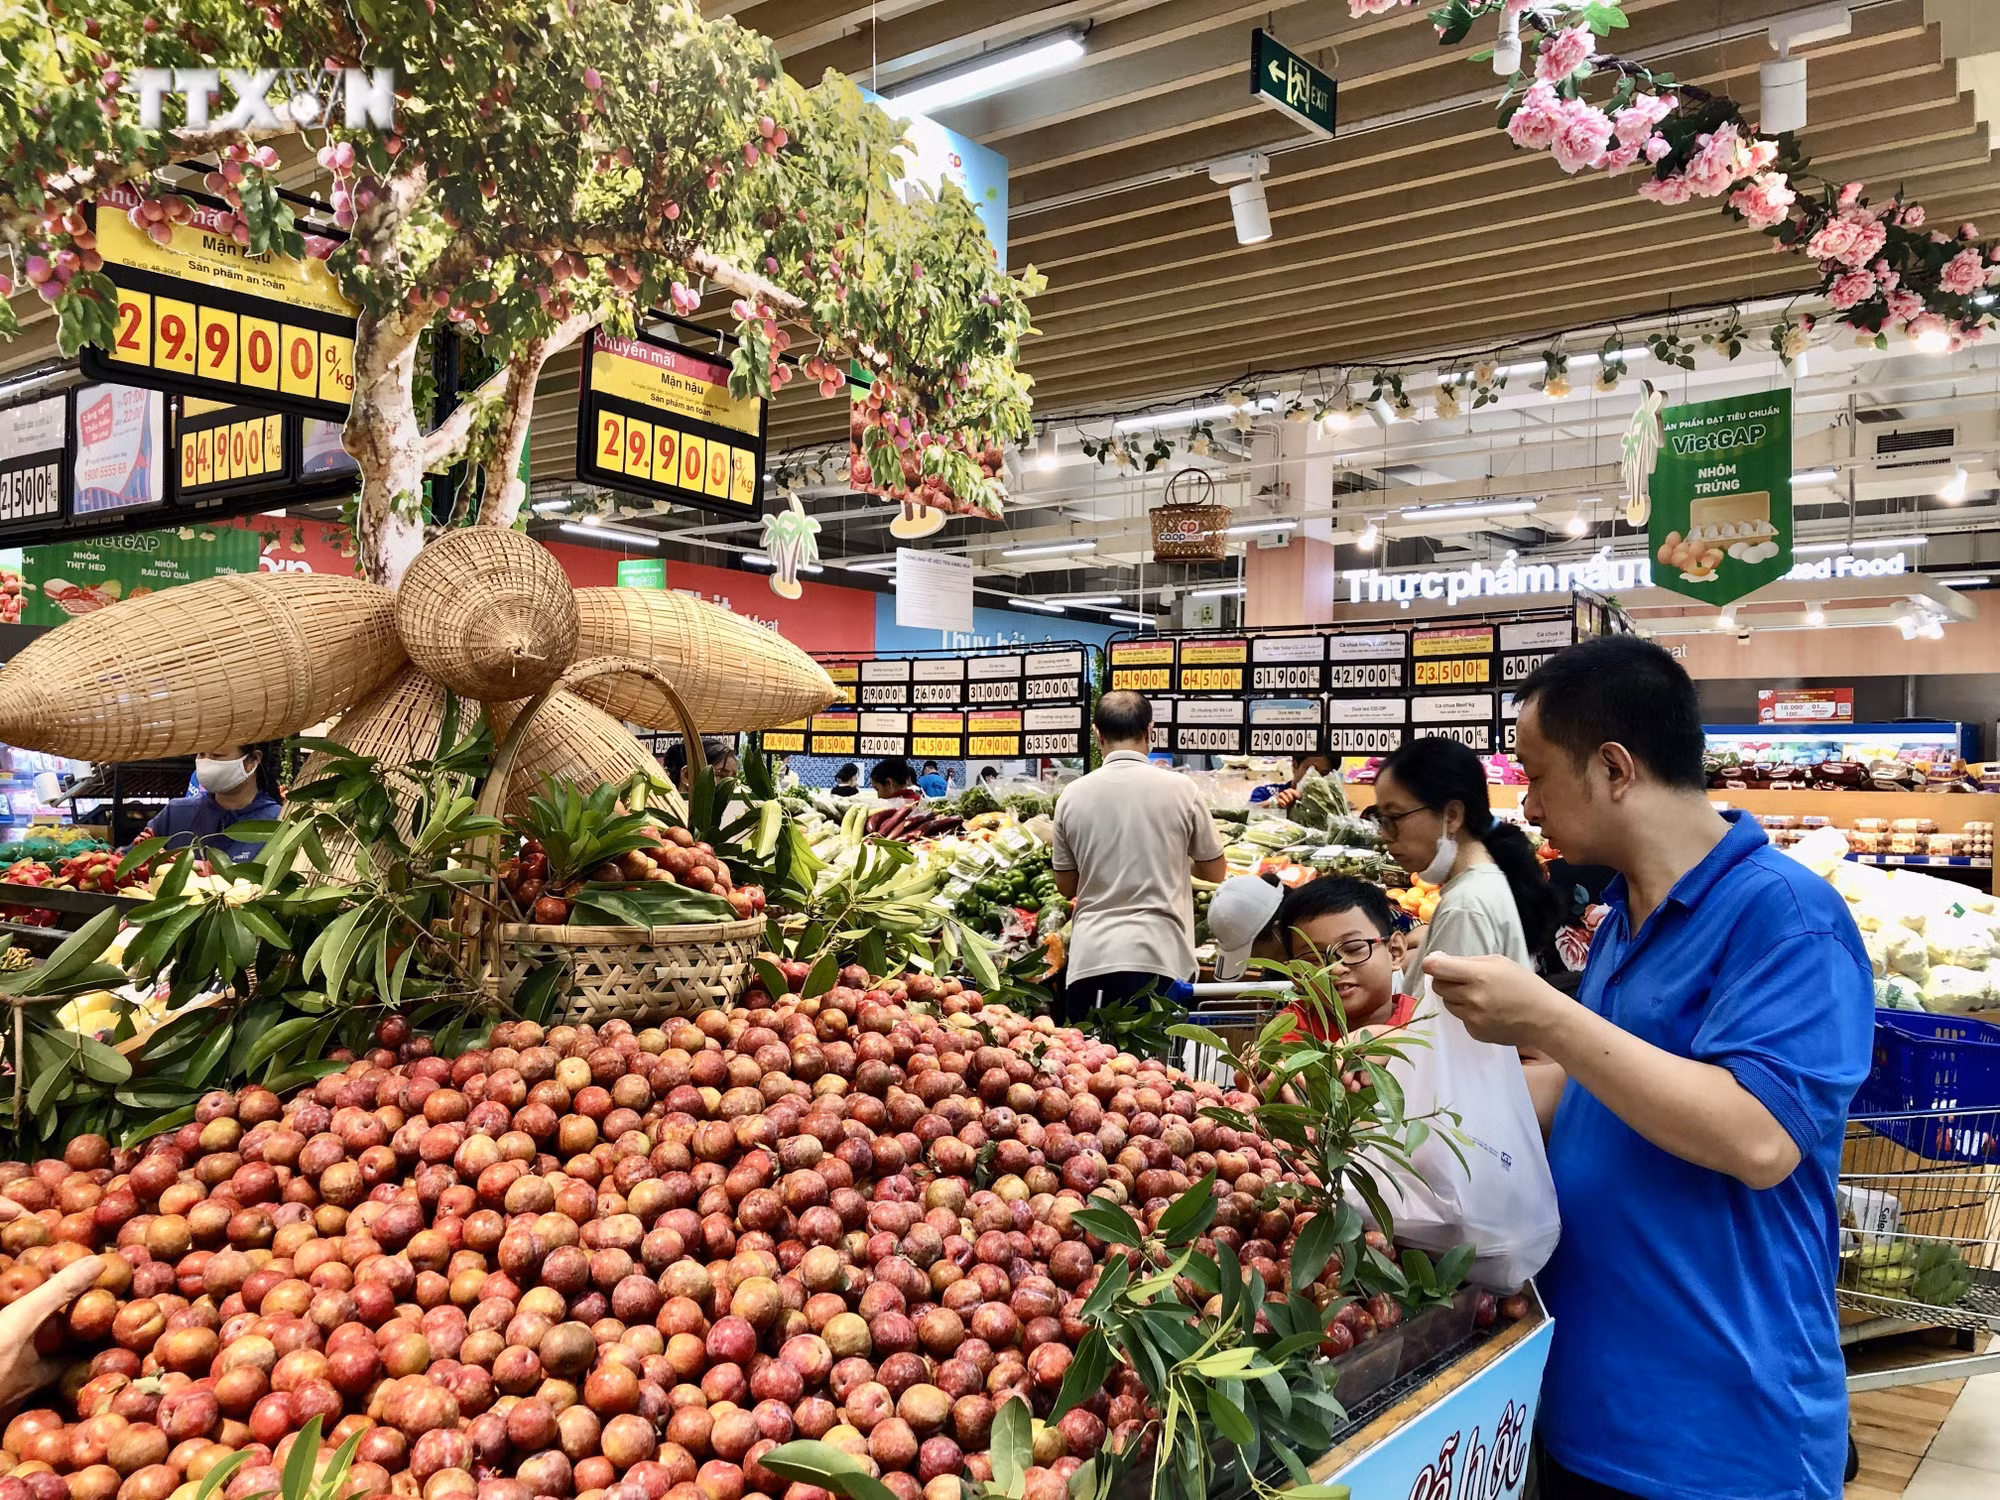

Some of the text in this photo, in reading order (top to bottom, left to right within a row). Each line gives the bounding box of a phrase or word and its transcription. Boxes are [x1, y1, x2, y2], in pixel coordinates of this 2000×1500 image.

[1311, 86, 1328, 112] EXIT
[203, 235, 236, 257] Mận
[188, 260, 285, 290] Sản phẩm an toàn
[117, 302, 355, 390] 29.900 đ/kg
[593, 331, 675, 368] Khuyến mãi
[661, 372, 682, 389] Mận
[685, 379, 704, 396] hậu
[123, 389, 145, 407] 07:00
[650, 393, 665, 403] Sản
[666, 398, 685, 410] phẩm
[696, 406, 712, 416] toàn
[1679, 417, 1704, 431] PHẨM
[1706, 415, 1724, 426] ĐẠT
[1726, 411, 1746, 422] TIÊU
[1748, 407, 1780, 419] CHUẨN
[1672, 424, 1766, 455] VietGAP
[185, 424, 281, 478] 84.900 đ/kg
[603, 419, 753, 493] 29.900 đ/kg
[84, 461, 128, 482] 1900 5555 68
[1698, 463, 1737, 479] NHÓM
[1695, 479, 1741, 494] TRỨNG
[73, 551, 100, 561] NHÓM
[66, 561, 106, 572] THỊT HEO
[141, 568, 157, 577] RAU
[154, 560, 178, 570] NHÓM
[215, 566, 238, 575] NHÓM
[1836, 552, 1905, 578] Food
[1343, 568, 1450, 609] Thực
[1448, 549, 1555, 606] phẩm
[1557, 545, 1641, 592] nấu
[1255, 670, 1307, 684] 31.900
[1333, 667, 1401, 684] 42.900 đ/kg
[1417, 661, 1474, 681] 23.500
[1114, 673, 1158, 686] 34.900
[1183, 672, 1230, 686] 64.500
[864, 688, 898, 700] 29.000
[915, 686, 951, 699] 26.900
[970, 684, 1009, 698] 31.000
[1027, 681, 1068, 696] 52.000
[765, 735, 796, 747] 28.900
[813, 735, 846, 748] 28.500
[862, 737, 896, 750] 42.000
[971, 738, 1009, 751] 17.900
[1026, 736, 1068, 750] 63.500
[1180, 732, 1226, 745] 64.000
[1253, 732, 1303, 746] 29.000
[1332, 731, 1400, 747] 31.000 đ/kg
[1476, 730, 1488, 744] đ/kg
[914, 738, 951, 752] 14.500
